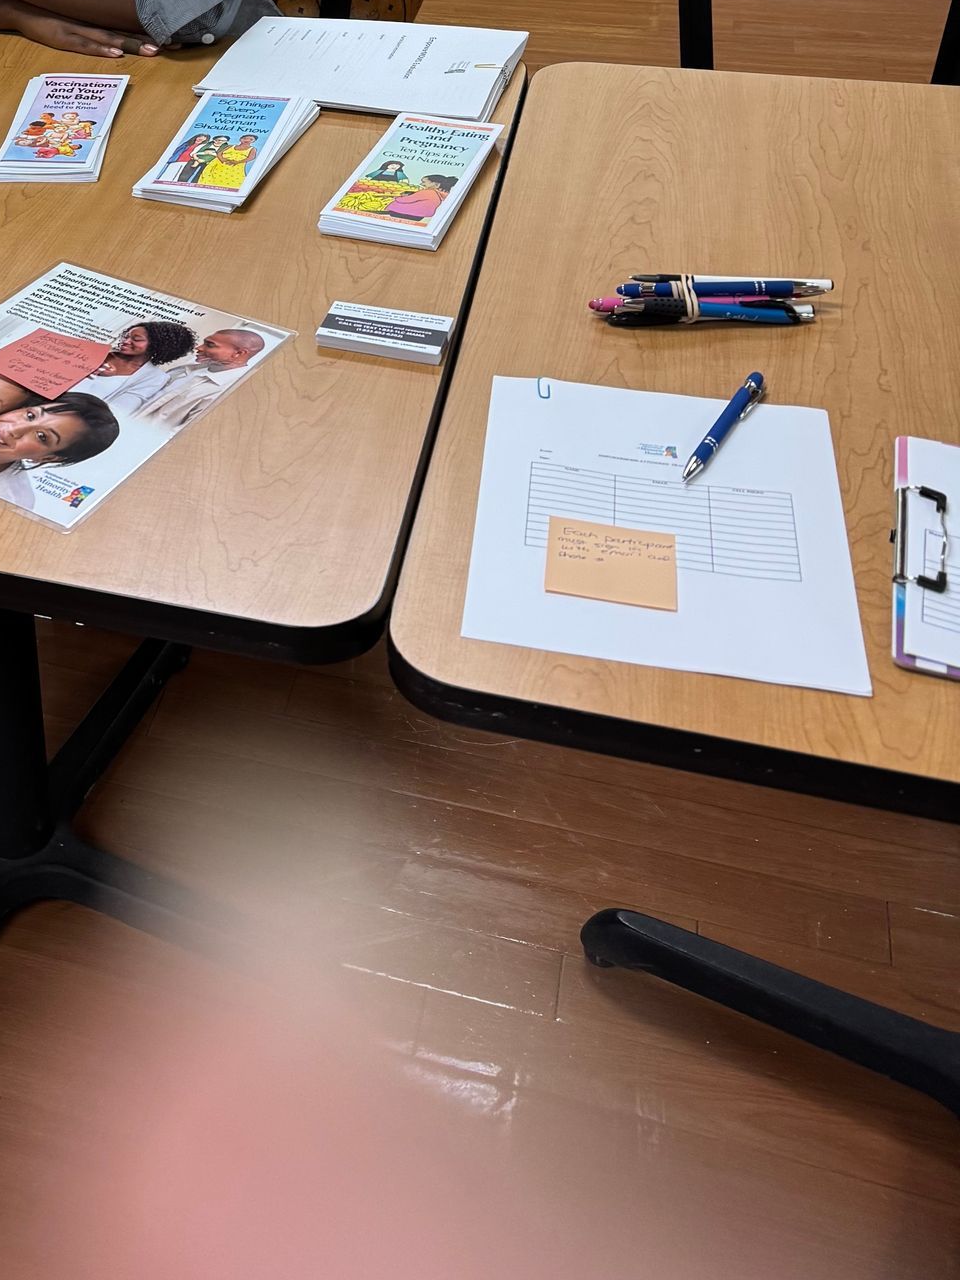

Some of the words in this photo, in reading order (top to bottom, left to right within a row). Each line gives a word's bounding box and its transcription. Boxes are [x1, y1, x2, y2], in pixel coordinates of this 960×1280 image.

[45, 81, 118, 89] Vaccinations
[227, 106, 260, 114] Every
[238, 100, 276, 108] Things
[212, 111, 267, 121] Pregnant
[214, 118, 257, 126] Woman
[194, 123, 234, 132] Should
[236, 125, 269, 134] Know
[399, 122, 449, 136] Healthy
[450, 129, 490, 141] Eating
[400, 137, 470, 153] Pregnancy
[426, 135, 452, 143] and
[383, 151, 415, 161] Good
[417, 157, 465, 167] Nutrition
[399, 146, 418, 154] Ten
[421, 150, 441, 159] Tips
[37, 288, 75, 303] outcomes
[84, 302, 98, 310] the
[57, 274, 89, 288] Minority
[90, 284, 115, 295] Health
[116, 292, 181, 317] EmpowerMoms
[78, 272, 111, 287] Institute
[111, 283, 123, 291] for
[125, 288, 138, 296] the
[138, 293, 194, 313] Advancement
[43, 283, 78, 297] maternal
[79, 293, 95, 301] and
[95, 298, 119, 311] infant
[121, 307, 146, 319] health
[44, 296, 64, 306] Delta
[65, 302, 91, 315] region.
[50, 278, 78, 290] Project
[78, 287, 101, 298] seeks
[101, 294, 119, 304] your
[120, 300, 143, 313] input
[152, 311, 187, 326] improve
[36, 485, 62, 499] Health
[37, 477, 70, 494] Minority
